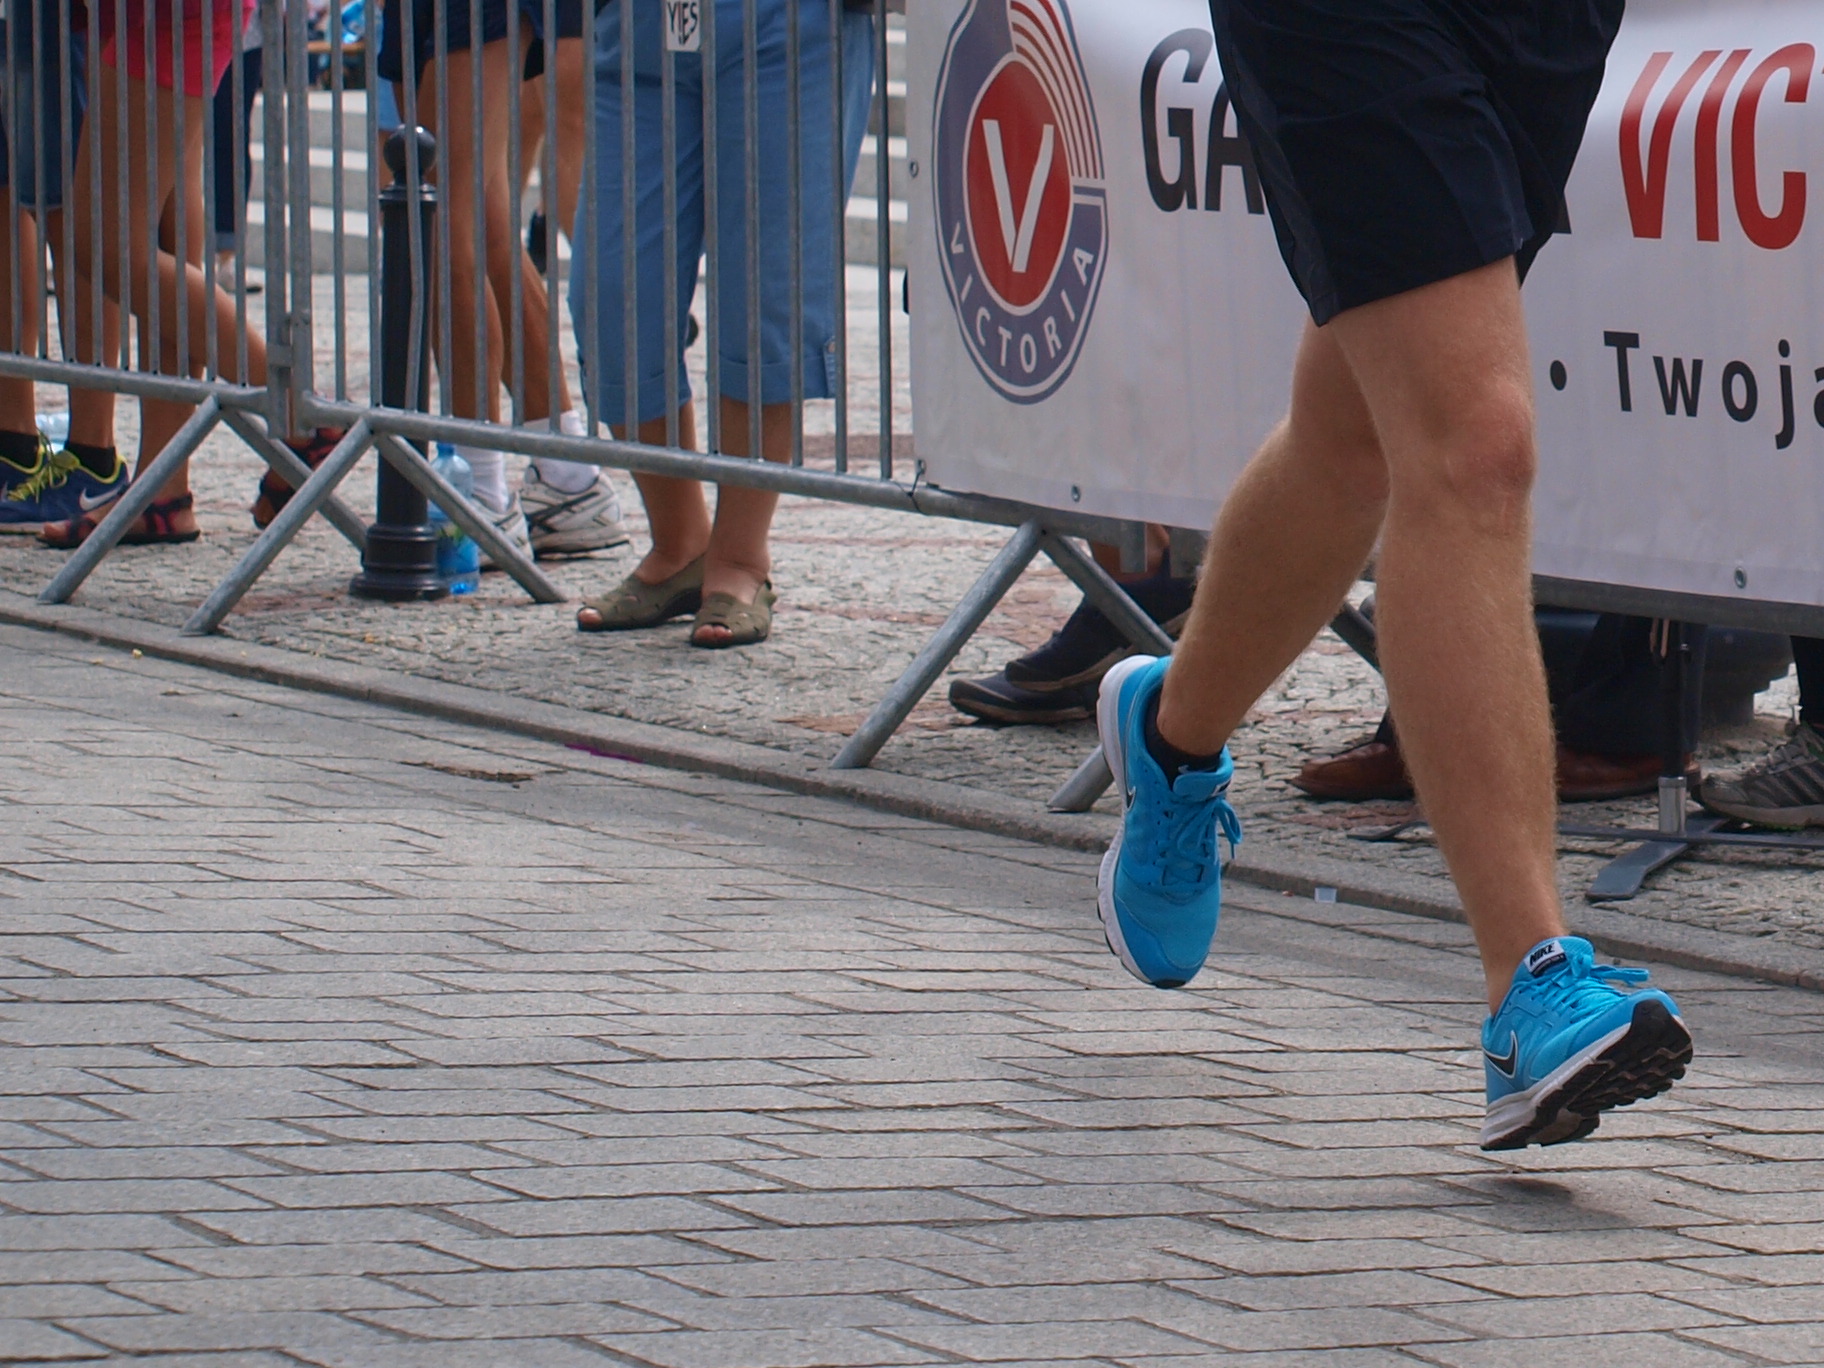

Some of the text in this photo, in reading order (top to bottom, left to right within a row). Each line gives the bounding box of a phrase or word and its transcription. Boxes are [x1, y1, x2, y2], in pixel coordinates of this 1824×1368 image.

[1139, 27, 1266, 215] GA
[950, 221, 1094, 374] VICTORIA
[1529, 942, 1556, 967] NIKE
